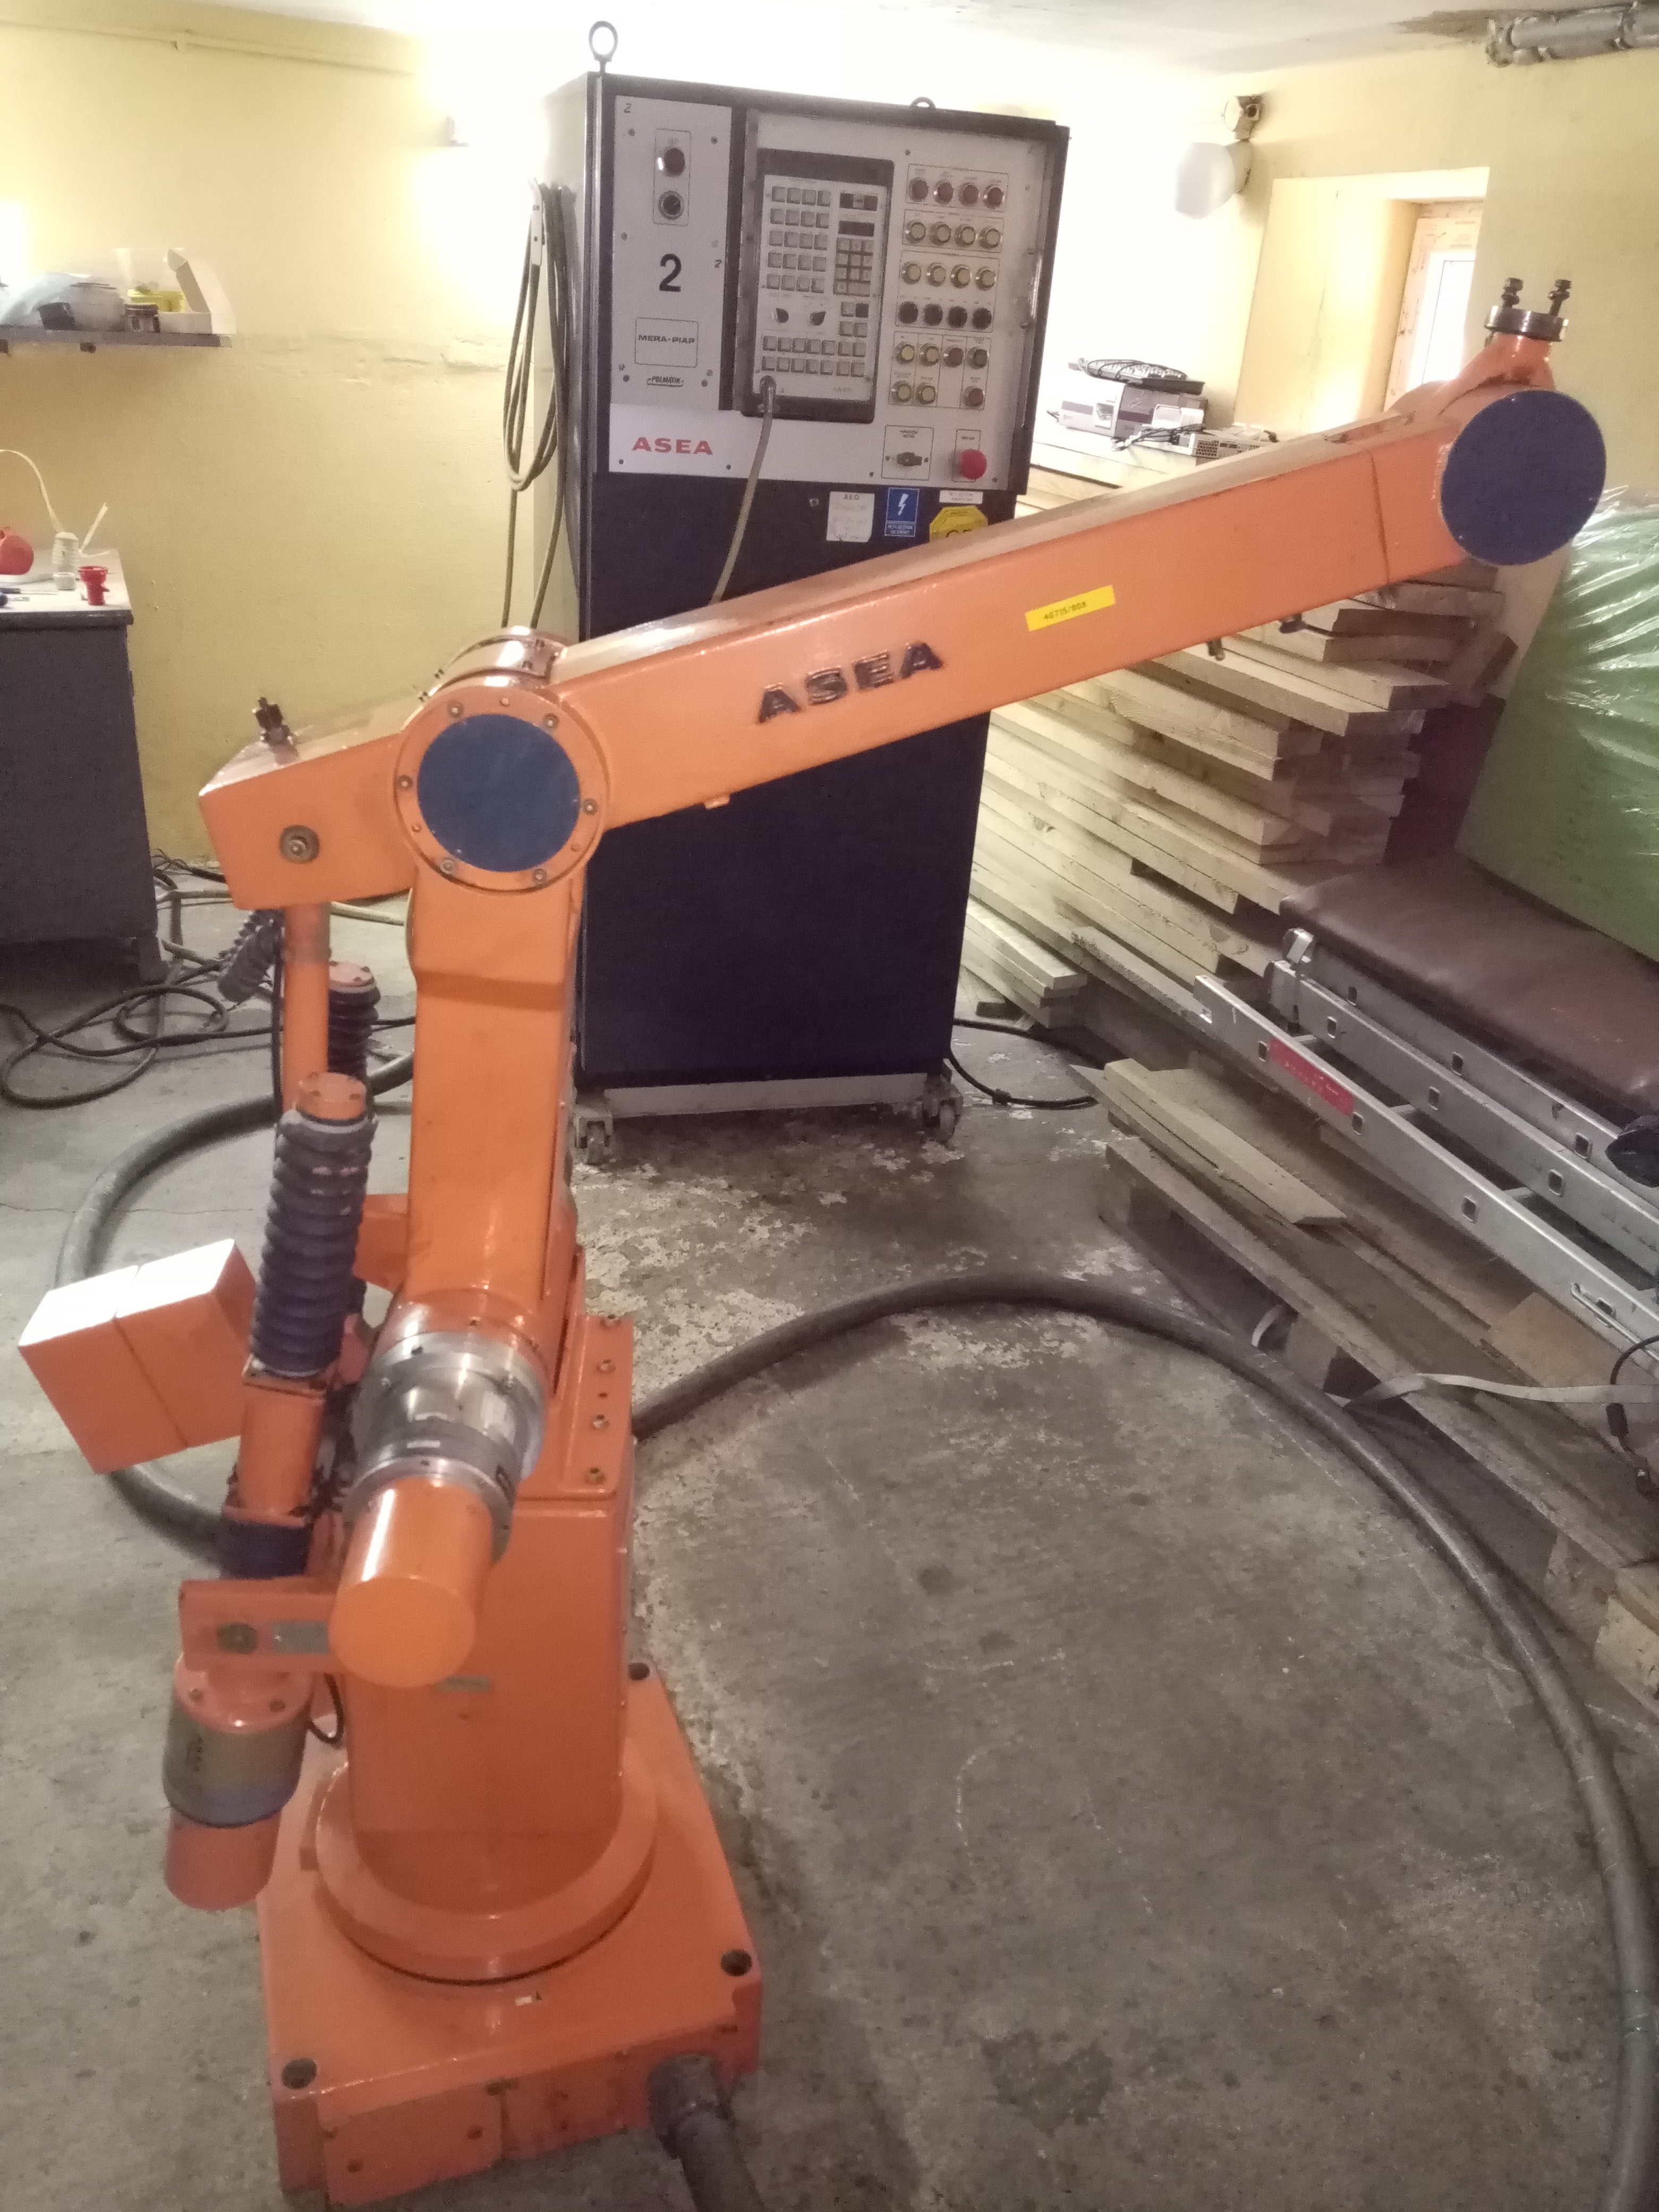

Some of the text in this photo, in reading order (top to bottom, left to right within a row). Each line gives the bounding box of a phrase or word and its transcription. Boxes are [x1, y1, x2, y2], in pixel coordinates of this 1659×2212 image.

[659, 253, 682, 292] 2
[638, 334, 695, 343] MERA-PIAP
[632, 437, 713, 456] ASEA
[757, 641, 944, 724] ASEA
